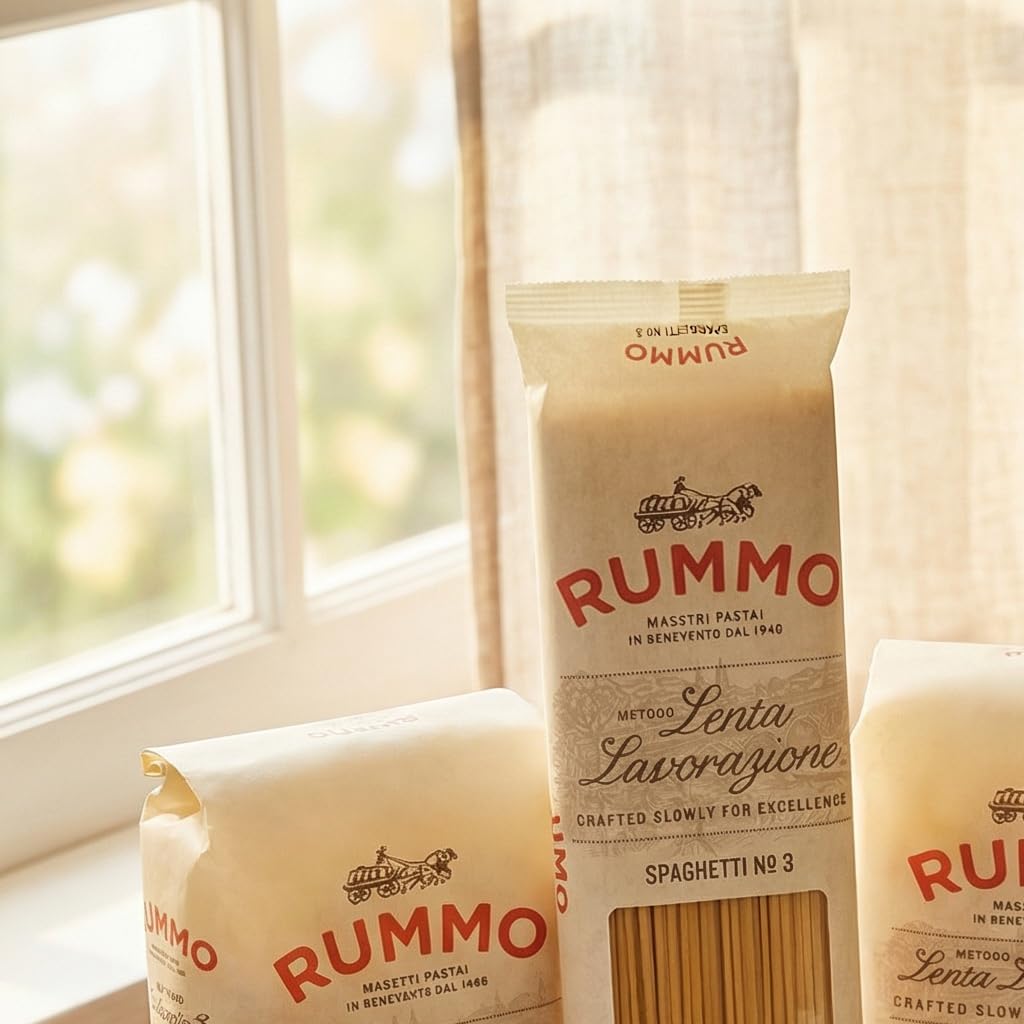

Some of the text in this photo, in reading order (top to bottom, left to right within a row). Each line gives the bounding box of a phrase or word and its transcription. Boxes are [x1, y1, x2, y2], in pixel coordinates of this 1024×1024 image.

[625, 335, 749, 366] RUMMO
[556, 540, 840, 628] RUMMO
[716, 609, 764, 623] PASTAI
[628, 635, 642, 646] IN
[726, 627, 750, 638] DAL
[658, 684, 794, 738] Lenta
[577, 792, 847, 827] CRAFTED SLOWLY FOR EXCELLENCE
[645, 856, 748, 885] SPAGHETTI
[782, 852, 794, 873] 3
[973, 913, 986, 925] IN
[144, 901, 218, 972] UMMO
[273, 903, 548, 1004] RUMMO
[897, 947, 998, 989] Lenta
[424, 964, 469, 982] PASTAI
[346, 1001, 360, 1012] IN
[435, 984, 458, 995] DAL
[893, 995, 968, 1016] CRAFTED
